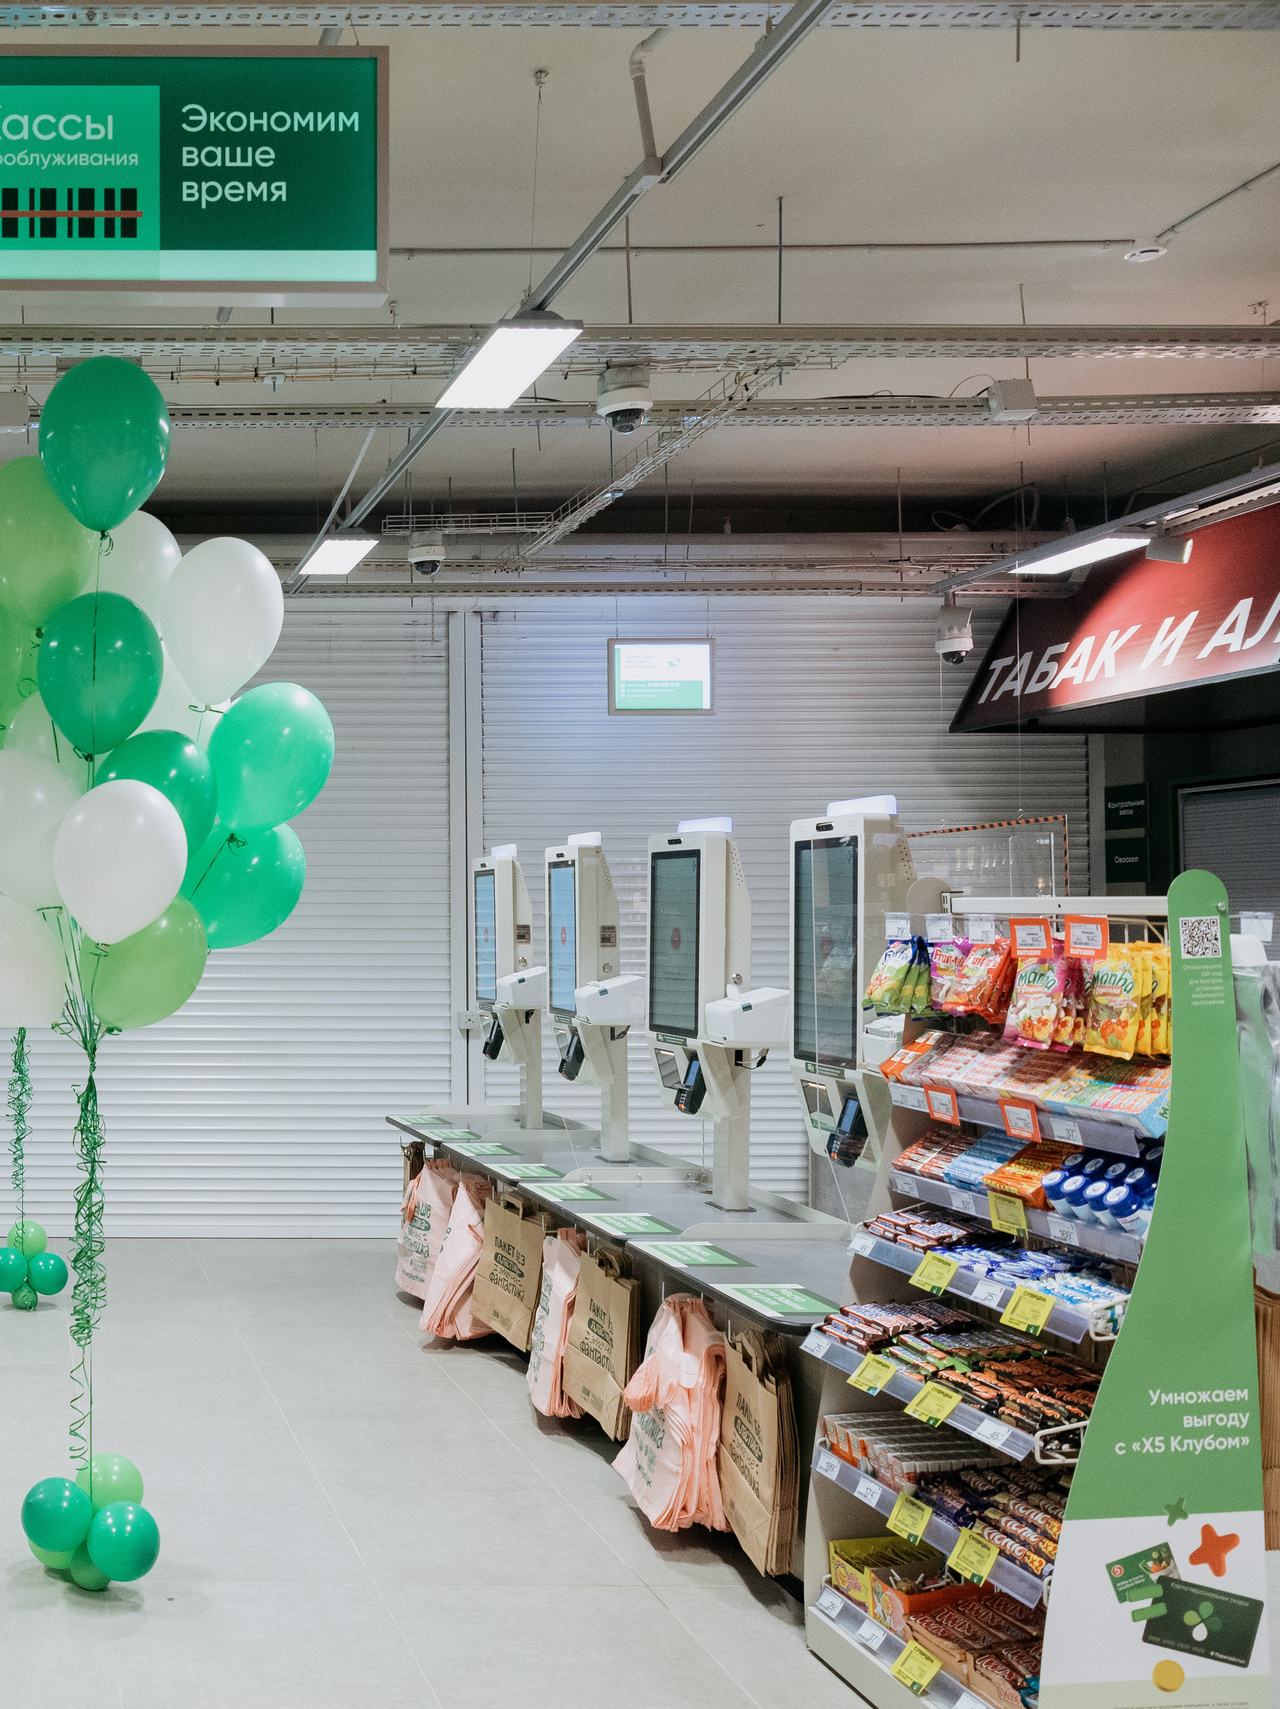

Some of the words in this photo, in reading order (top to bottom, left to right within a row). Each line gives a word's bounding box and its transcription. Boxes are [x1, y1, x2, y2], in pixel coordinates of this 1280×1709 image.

[181, 103, 360, 132] Экономим
[181, 146, 276, 168] ваше
[181, 181, 288, 209] время
[977, 624, 1142, 704] ТАБАК
[1138, 610, 1199, 671] И
[1108, 799, 1146, 809] Контрольные
[1114, 855, 1139, 864] Овоскоп
[1018, 970, 1058, 992] Mamba
[494, 1236, 515, 1260] ПАКЕТ
[1149, 1388, 1249, 1406] Умножаем
[1183, 1411, 1250, 1429] выгоду
[1114, 1442, 1126, 1455] с
[1170, 1434, 1251, 1455] Клубом»
[935, 1608, 976, 1636] TWIX
[959, 1600, 1000, 1625] TWIX
